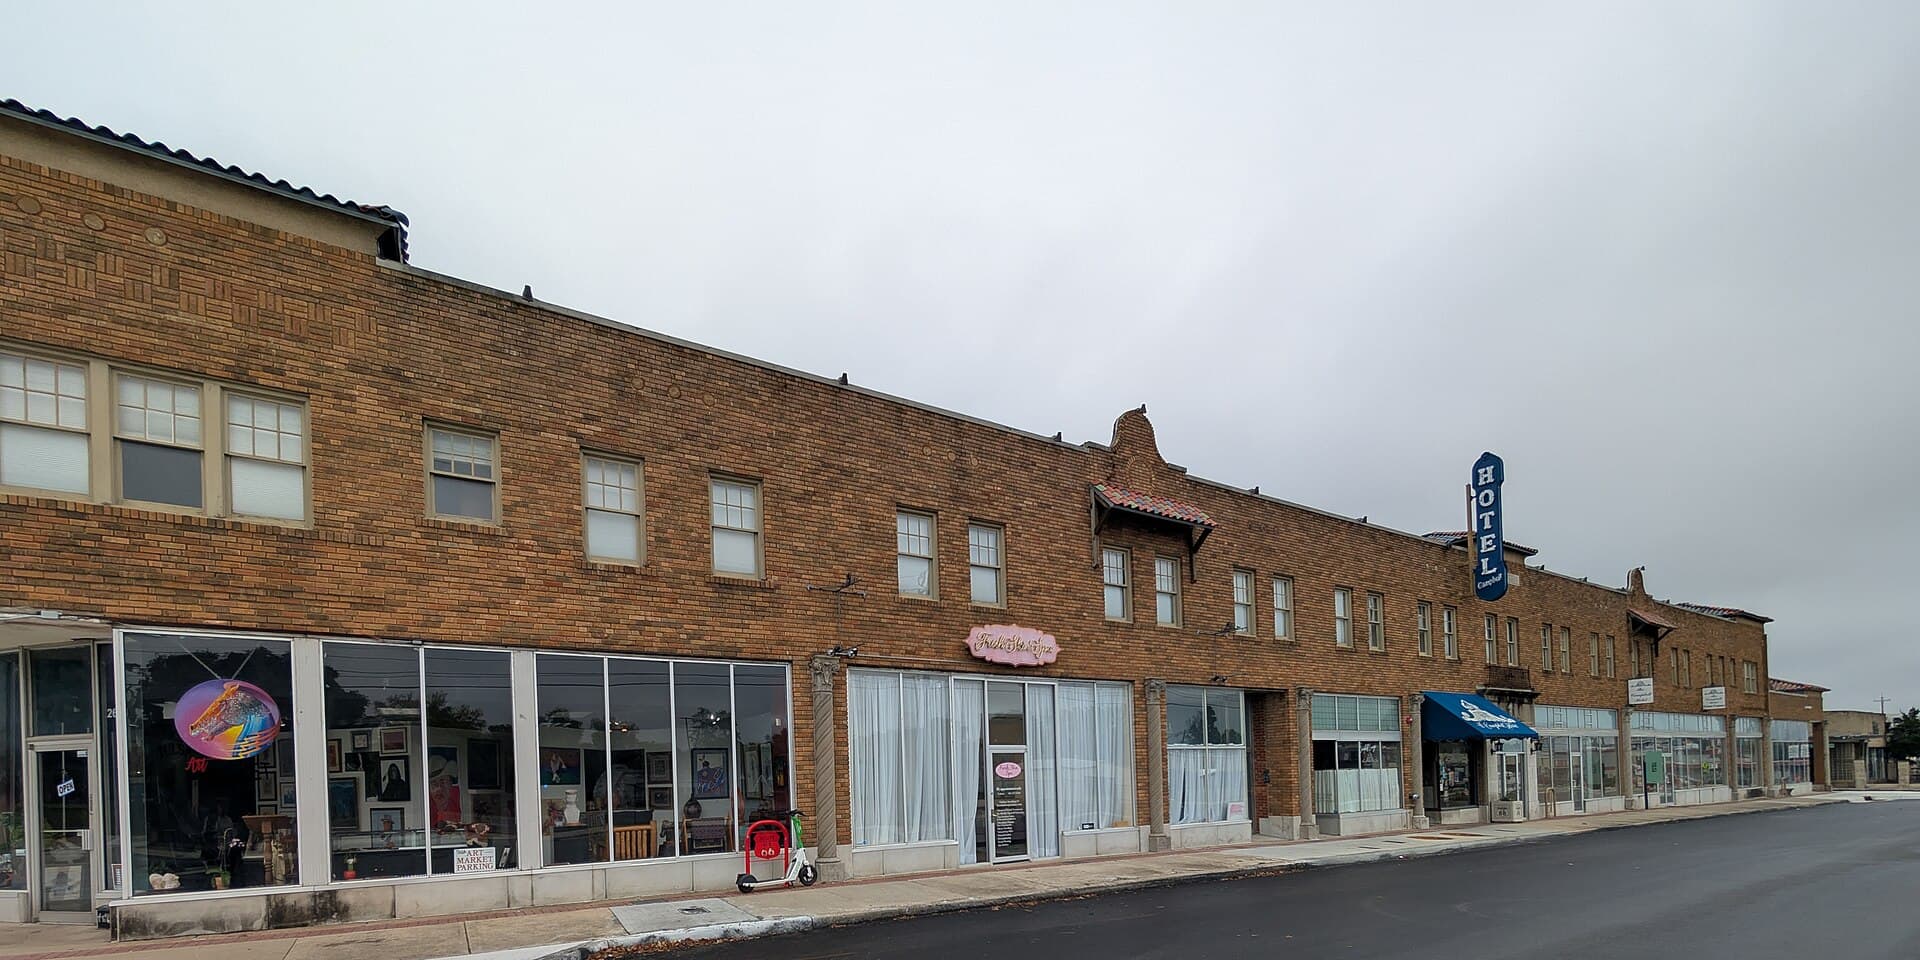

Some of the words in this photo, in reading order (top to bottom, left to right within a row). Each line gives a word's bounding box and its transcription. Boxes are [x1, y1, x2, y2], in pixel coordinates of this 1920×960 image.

[1478, 466, 1497, 575] HOTEL
[59, 782, 74, 794] OPEN
[457, 856, 492, 864] MARKET
[457, 863, 493, 871] PARKING
